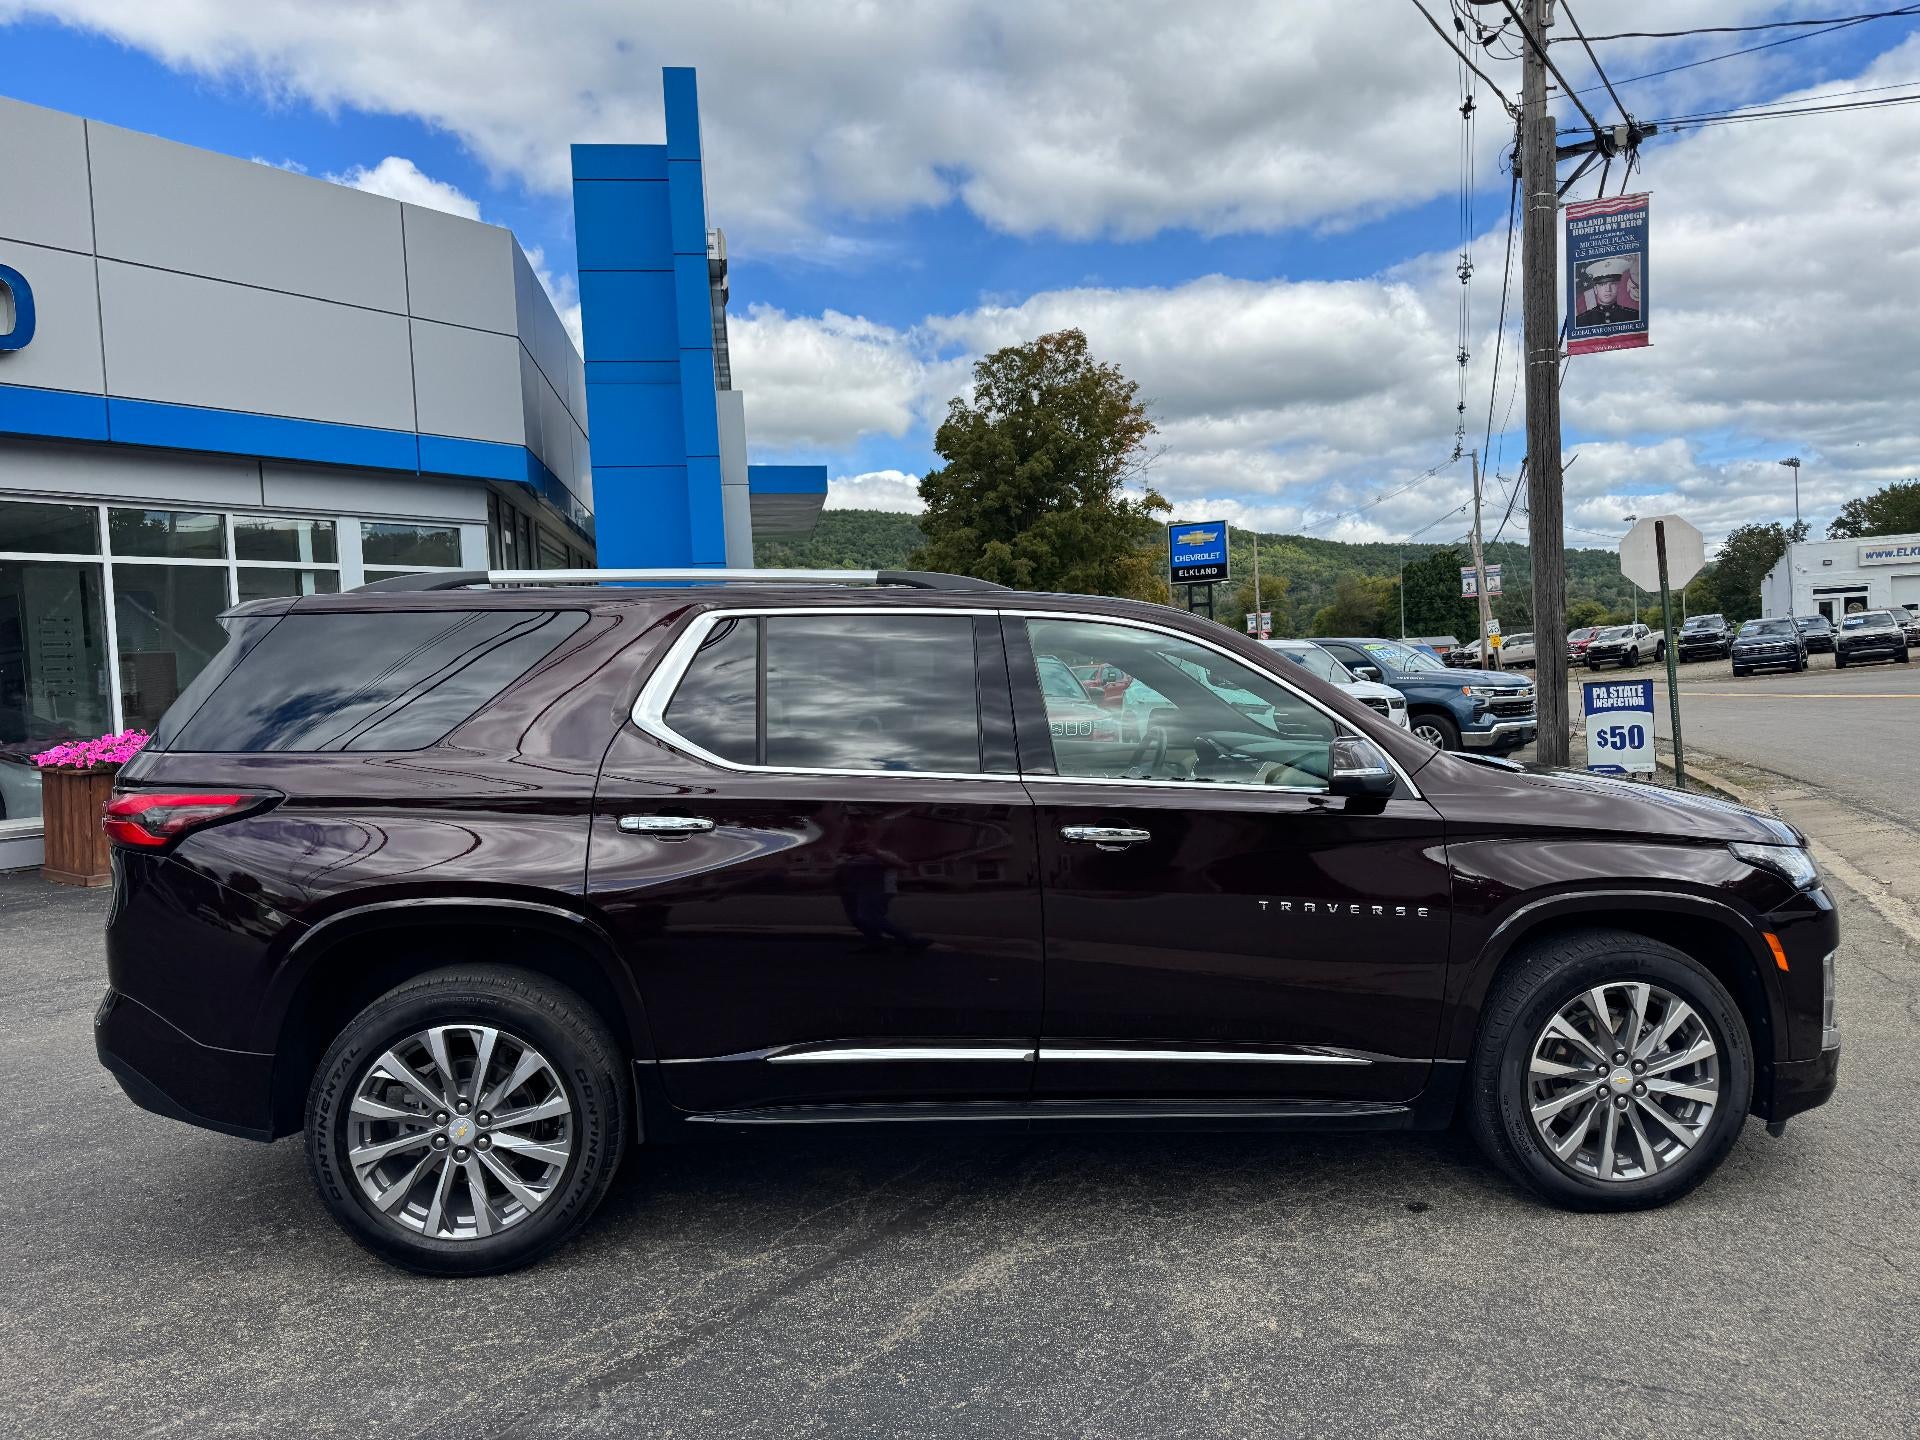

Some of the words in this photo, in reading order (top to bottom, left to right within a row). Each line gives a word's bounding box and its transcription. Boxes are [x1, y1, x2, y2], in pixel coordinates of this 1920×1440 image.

[1570, 218, 1603, 230] ELKLAND
[1606, 212, 1646, 224] BOROUGH
[1572, 223, 1618, 236] HOMETOWN
[1620, 219, 1642, 228] HERO
[1580, 239, 1610, 248] MICHAEL
[1612, 234, 1636, 244] PLANK
[1589, 245, 1616, 255] MARINE
[1617, 242, 1640, 251] CORPS
[1174, 552, 1220, 562] CHEVROLET
[1179, 567, 1218, 576] ELKLAND
[1593, 687, 1608, 698] PA
[1610, 684, 1644, 698] STATE
[1594, 696, 1644, 708] INSPECTION
[1596, 724, 1645, 750] $50
[1258, 900, 1429, 917] TRAVERSE
[318, 1047, 362, 1200] CONTINENTAL
[555, 1068, 600, 1220] CONTINENTAL
